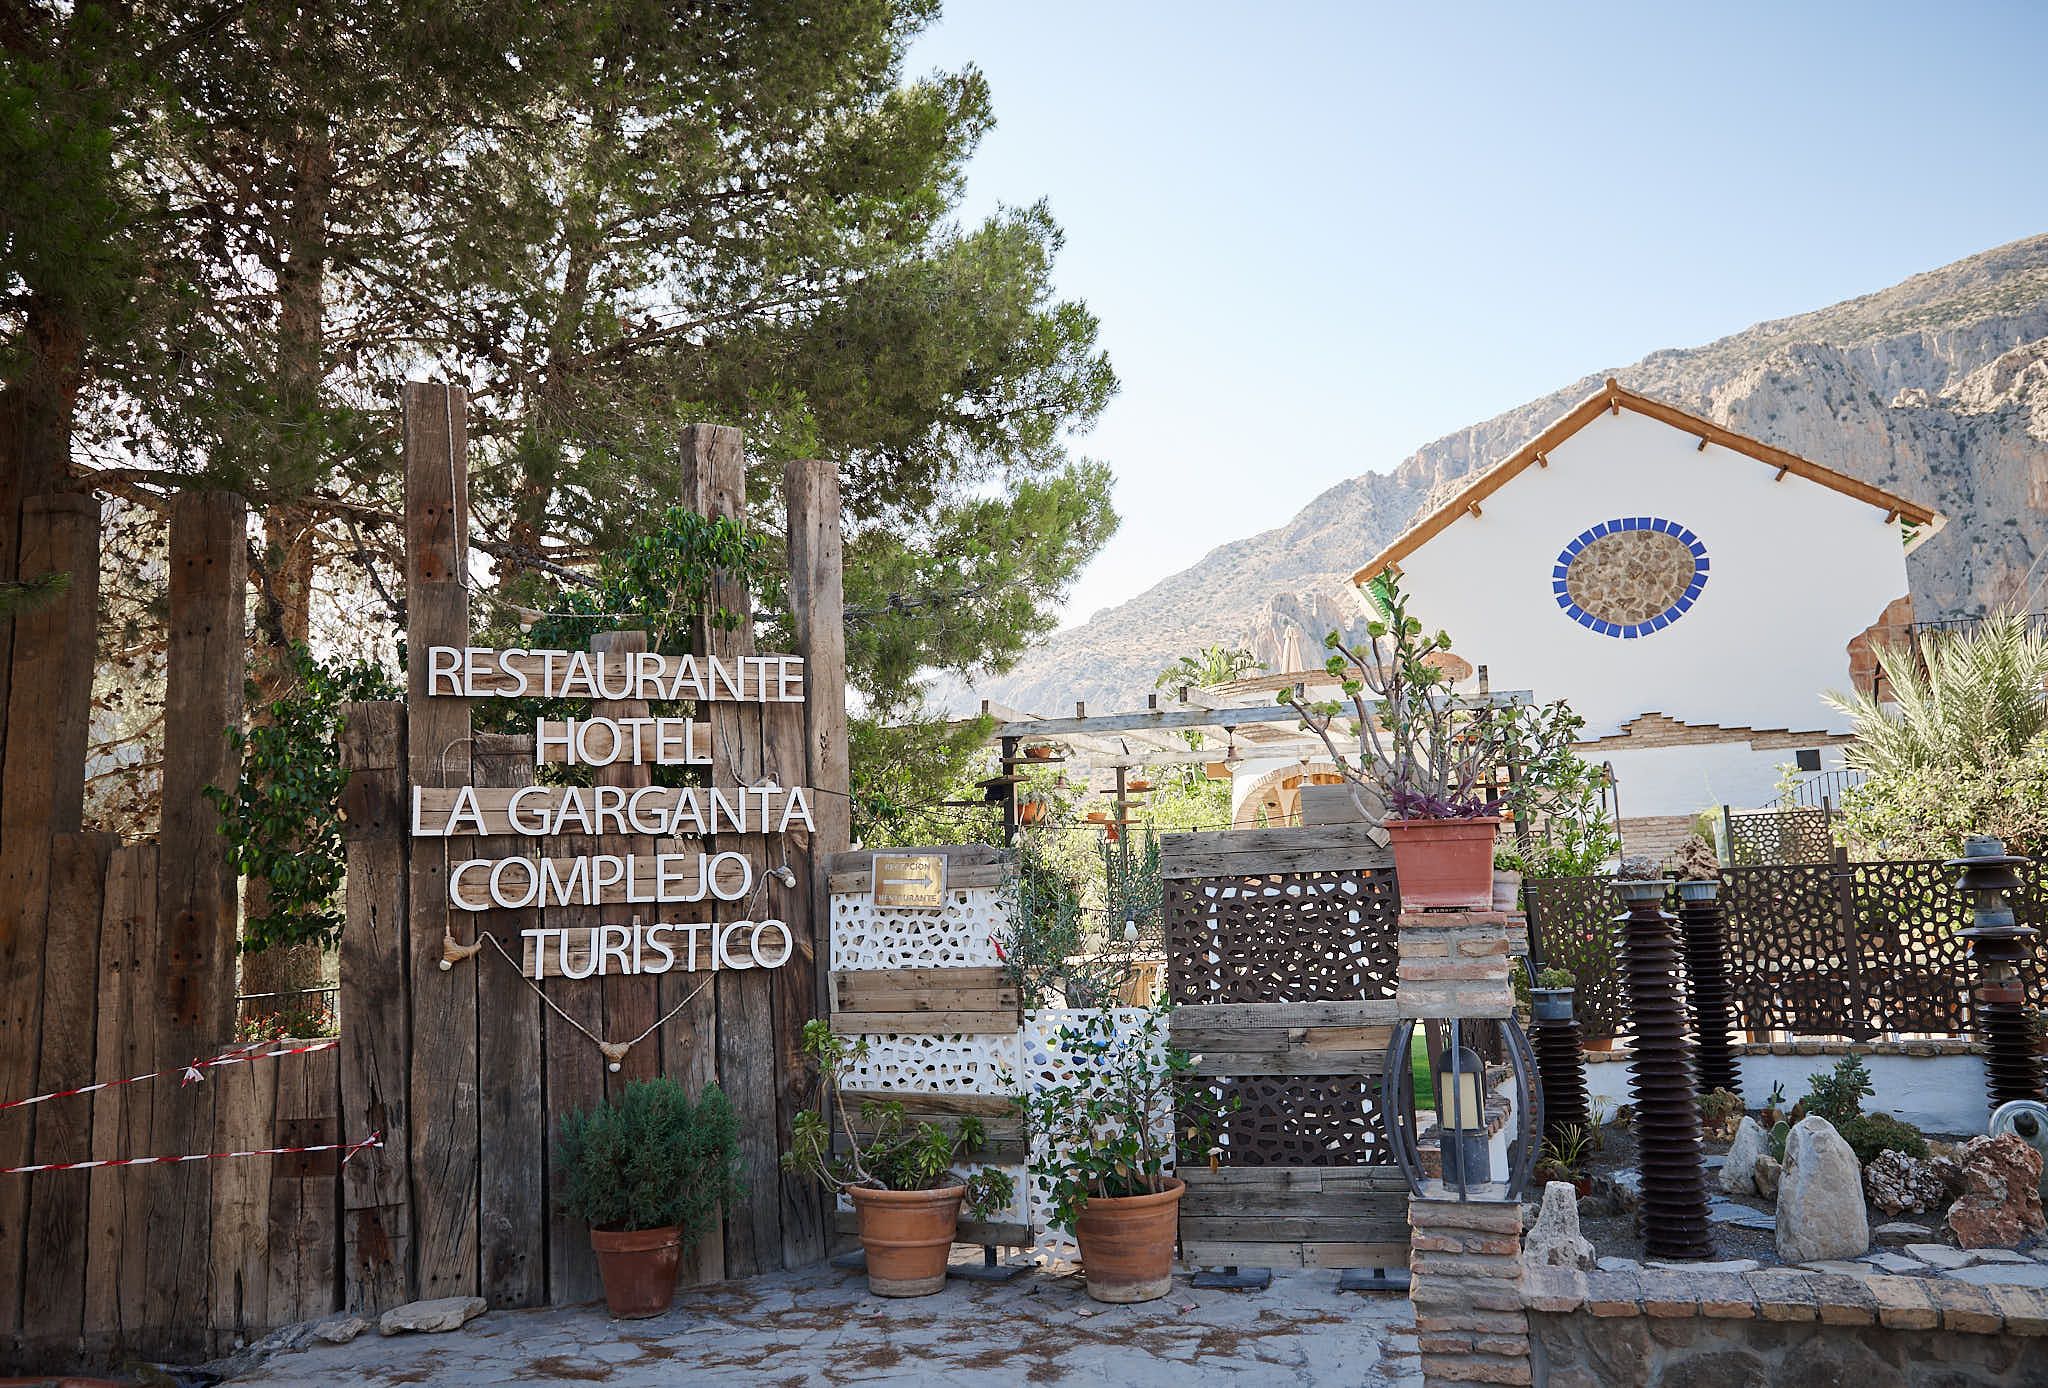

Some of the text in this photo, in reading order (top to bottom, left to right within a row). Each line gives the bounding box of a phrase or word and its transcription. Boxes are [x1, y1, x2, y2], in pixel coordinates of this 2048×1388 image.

[428, 646, 805, 702] RESTAURANTE
[536, 716, 713, 767] HOTEL
[412, 785, 816, 837] LA GARGANTA
[449, 851, 753, 912] COMPLEJO
